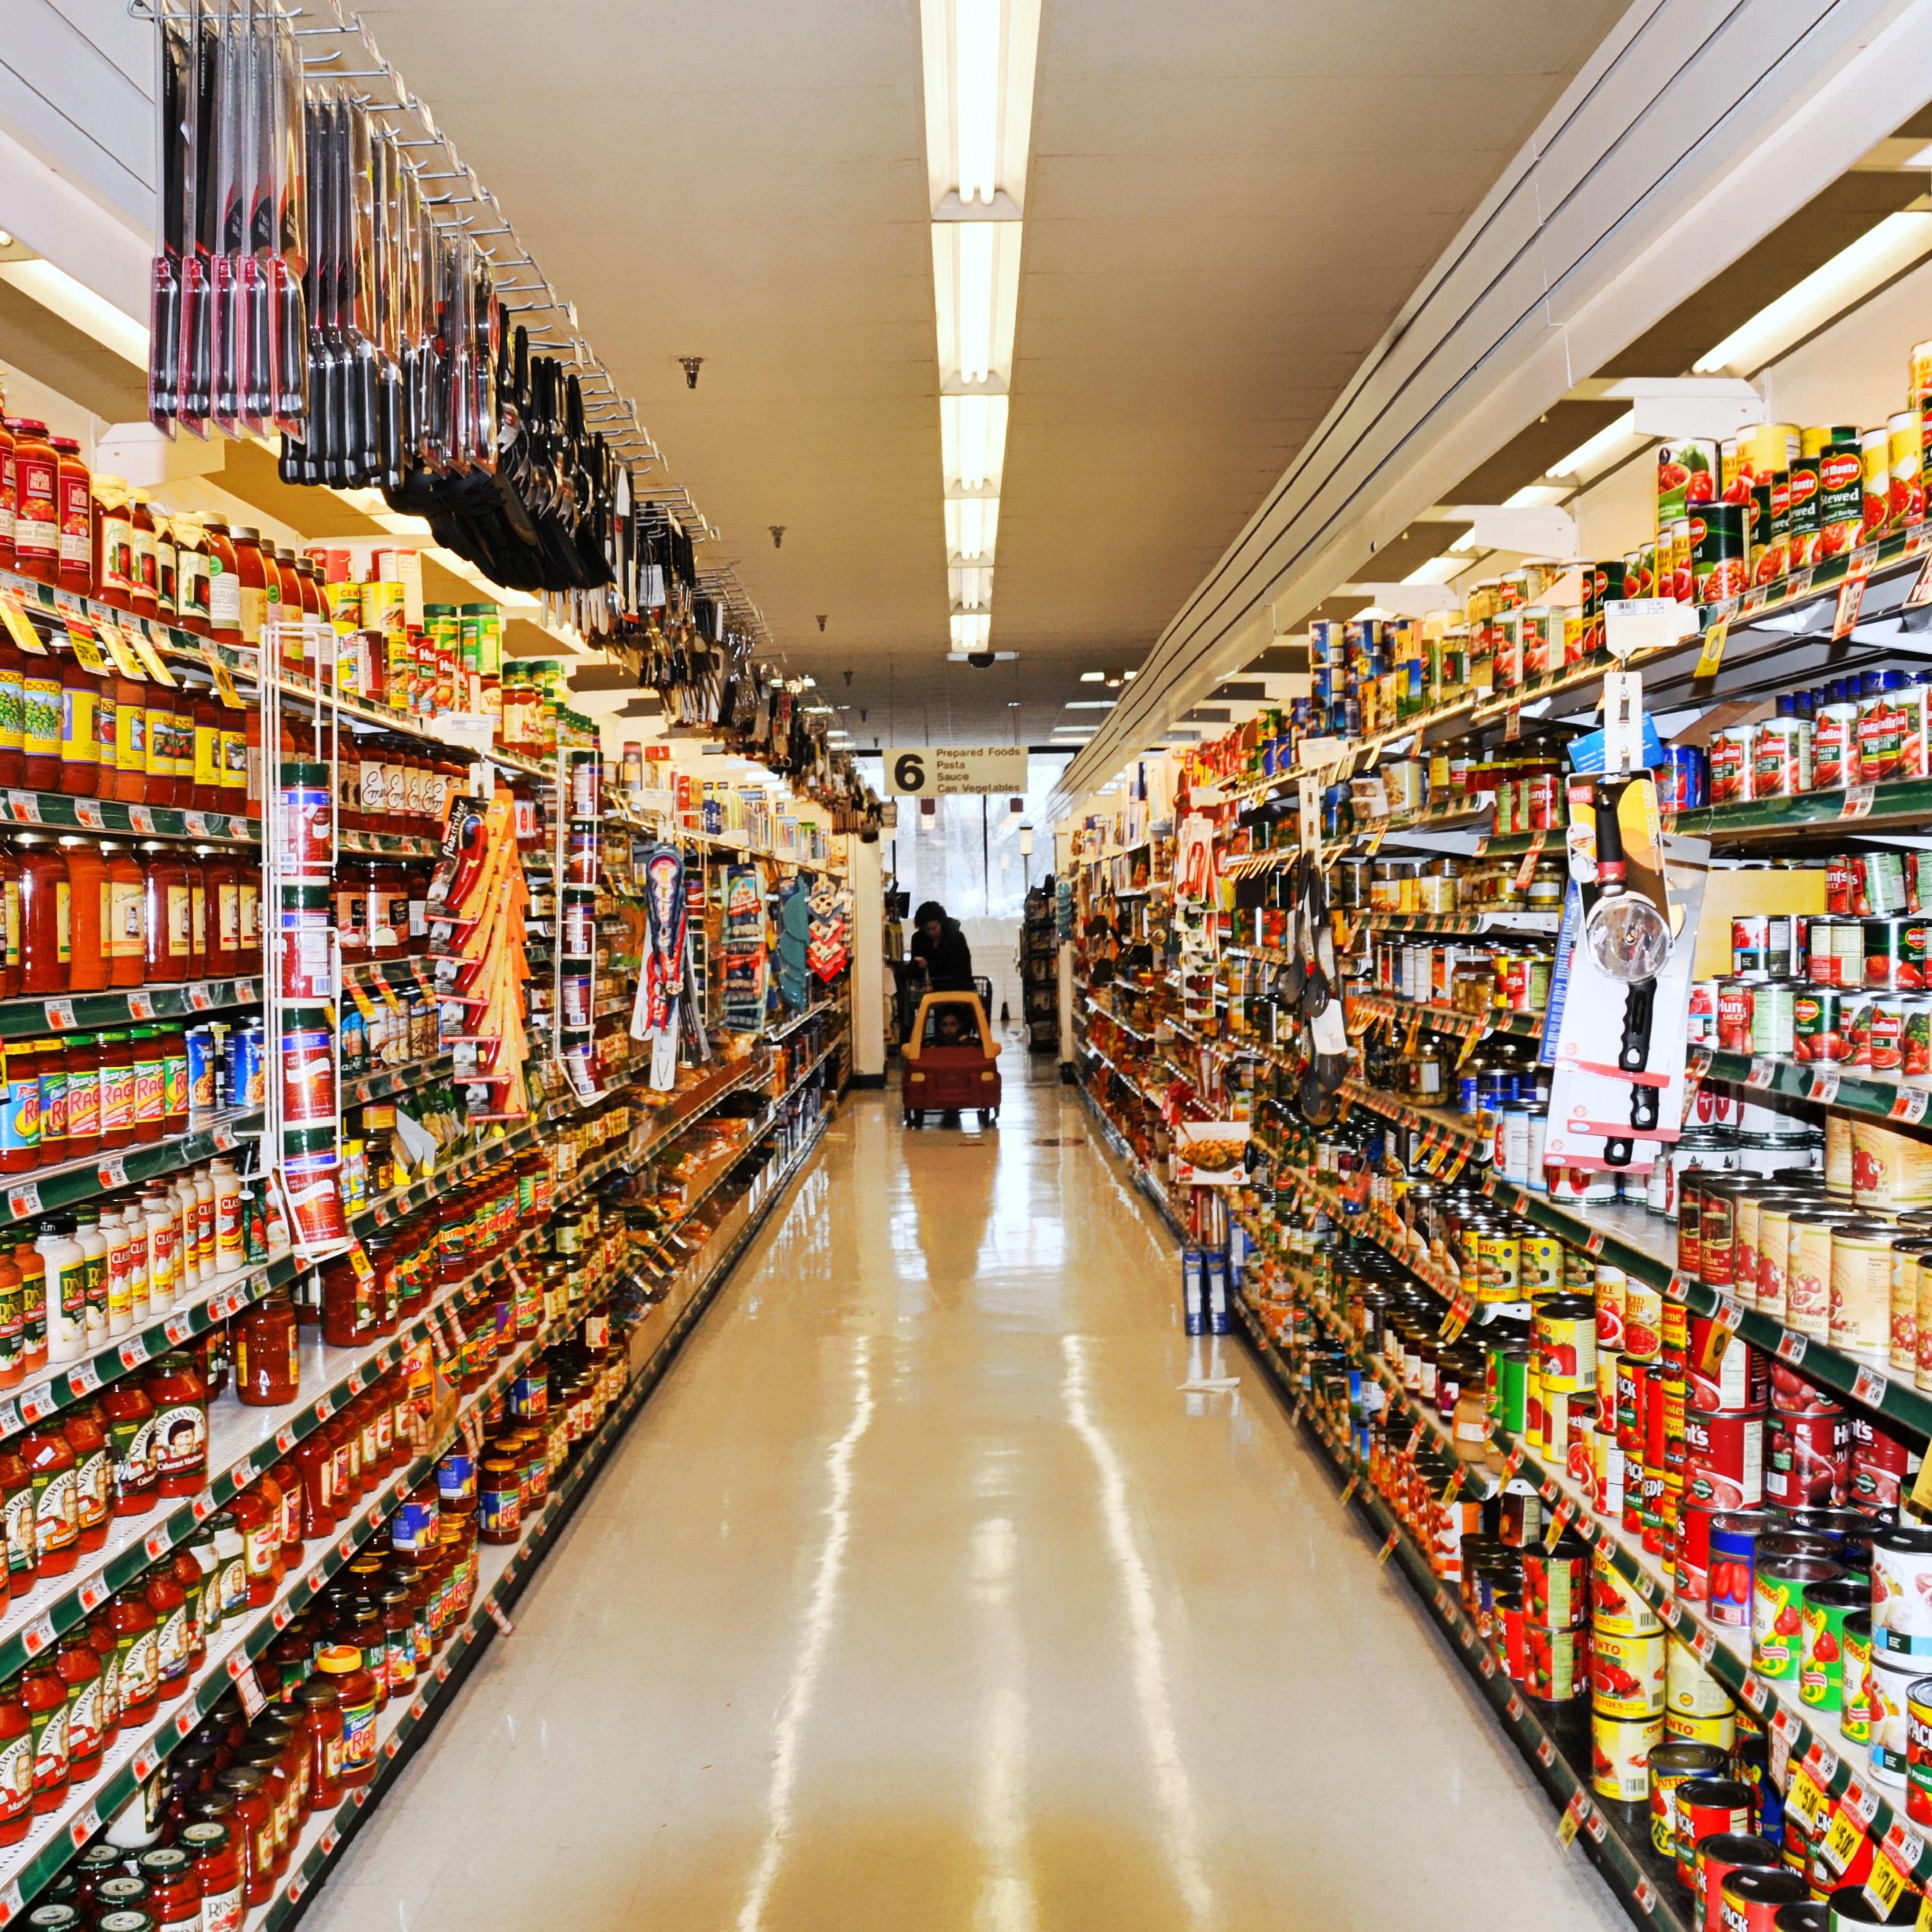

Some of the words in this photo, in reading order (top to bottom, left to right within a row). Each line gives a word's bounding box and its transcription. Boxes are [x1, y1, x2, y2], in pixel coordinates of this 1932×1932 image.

[1830, 463, 1858, 474] Monte
[936, 749, 983, 758] Prepared
[988, 747, 1020, 756] Foods
[937, 761, 965, 769] Pasta
[894, 754, 925, 792] 6
[937, 773, 969, 781] Sauce
[937, 785, 957, 793] Can
[962, 784, 1020, 794] Vegetables
